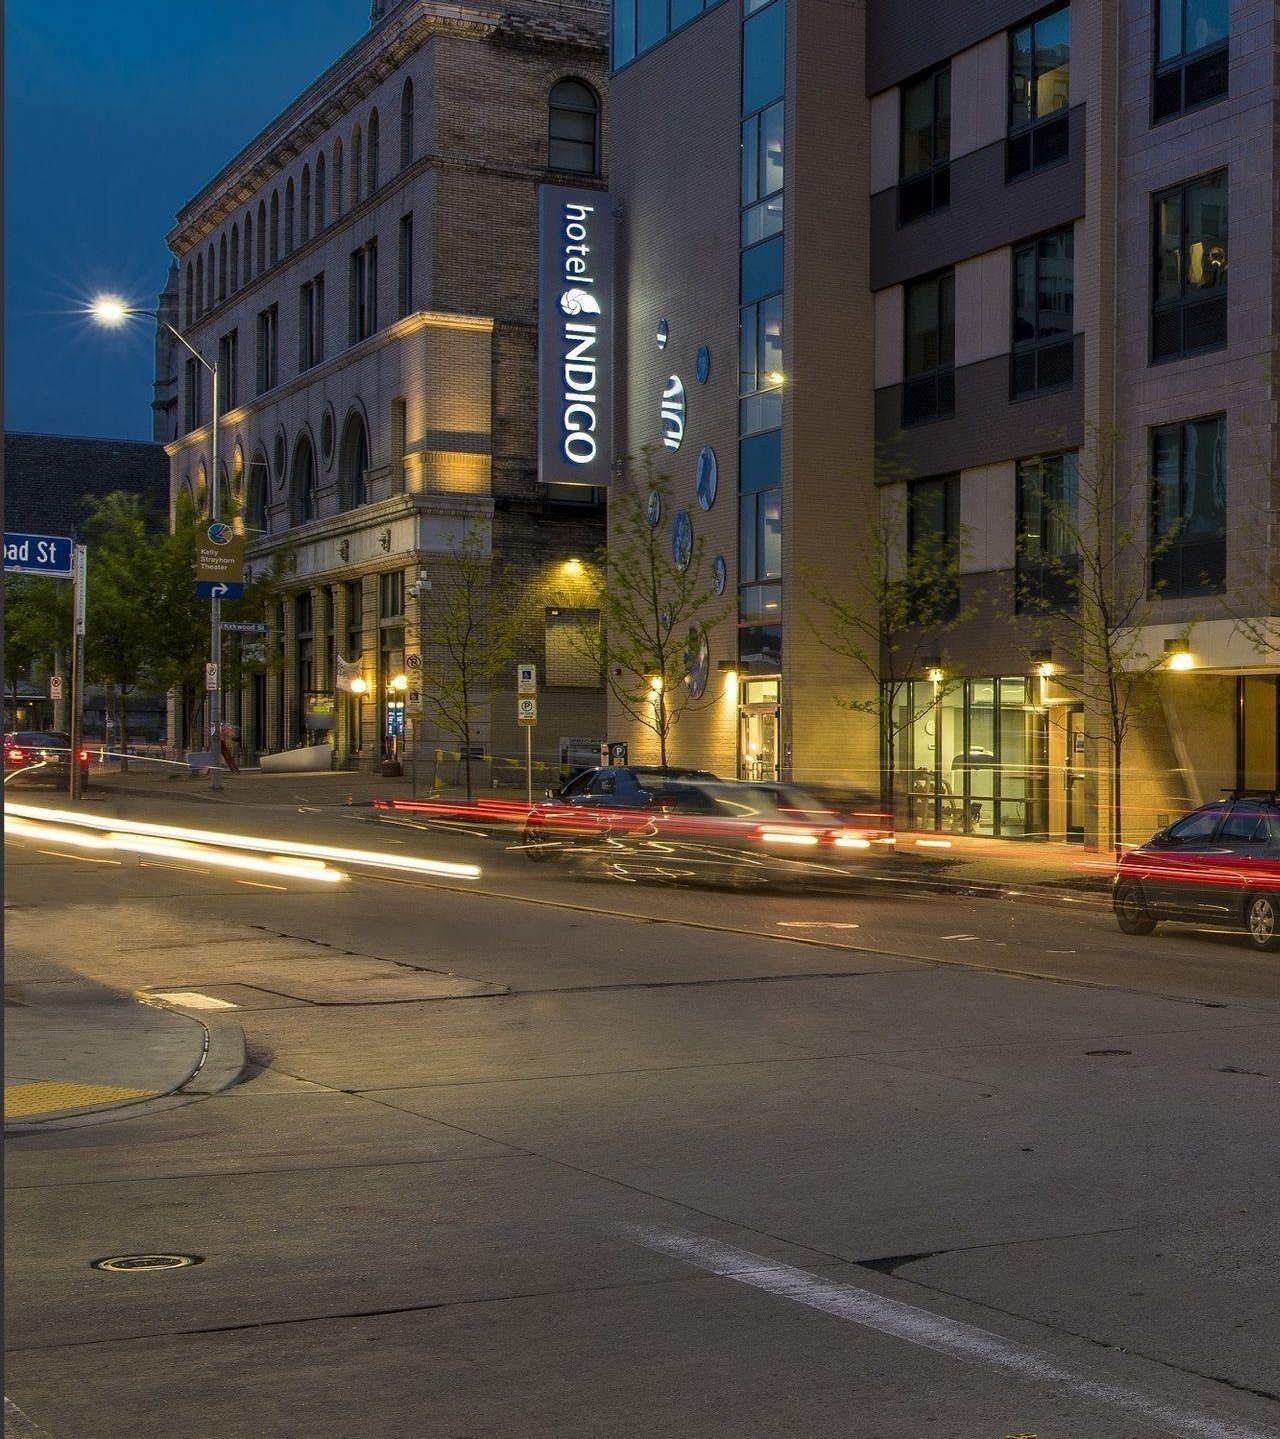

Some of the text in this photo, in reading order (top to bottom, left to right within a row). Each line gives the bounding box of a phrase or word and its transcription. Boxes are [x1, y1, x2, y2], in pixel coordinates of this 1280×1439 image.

[564, 203, 597, 464] hotel INDIGO
[37, 541, 56, 564] St
[201, 548, 218, 557] Kelly
[201, 556, 235, 564] Strayhorn
[201, 563, 228, 571] Theater
